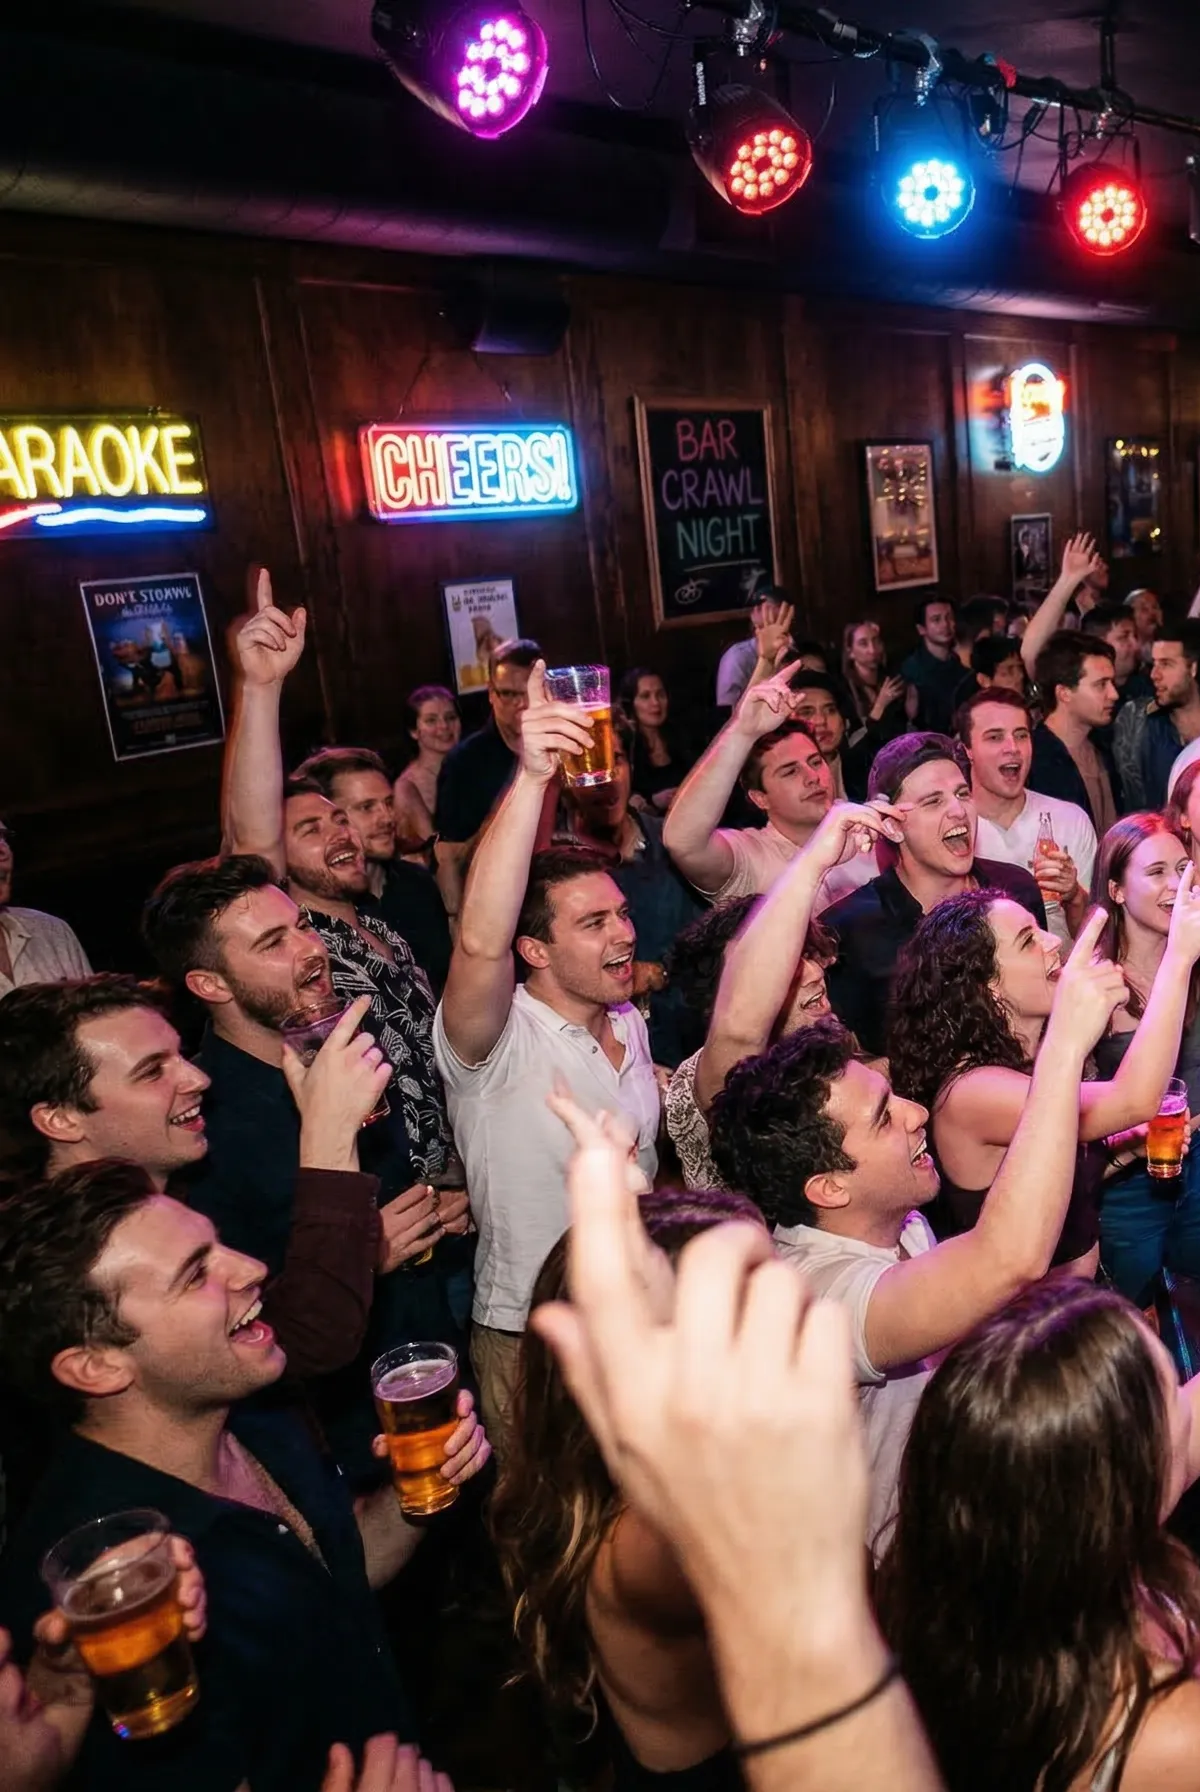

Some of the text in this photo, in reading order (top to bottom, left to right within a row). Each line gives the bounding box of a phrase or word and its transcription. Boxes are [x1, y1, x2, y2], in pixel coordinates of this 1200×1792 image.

[675, 418, 739, 462] BAR
[373, 431, 572, 509] CHEERS!
[661, 466, 764, 511] CRAWL
[676, 514, 761, 560] NIGHT
